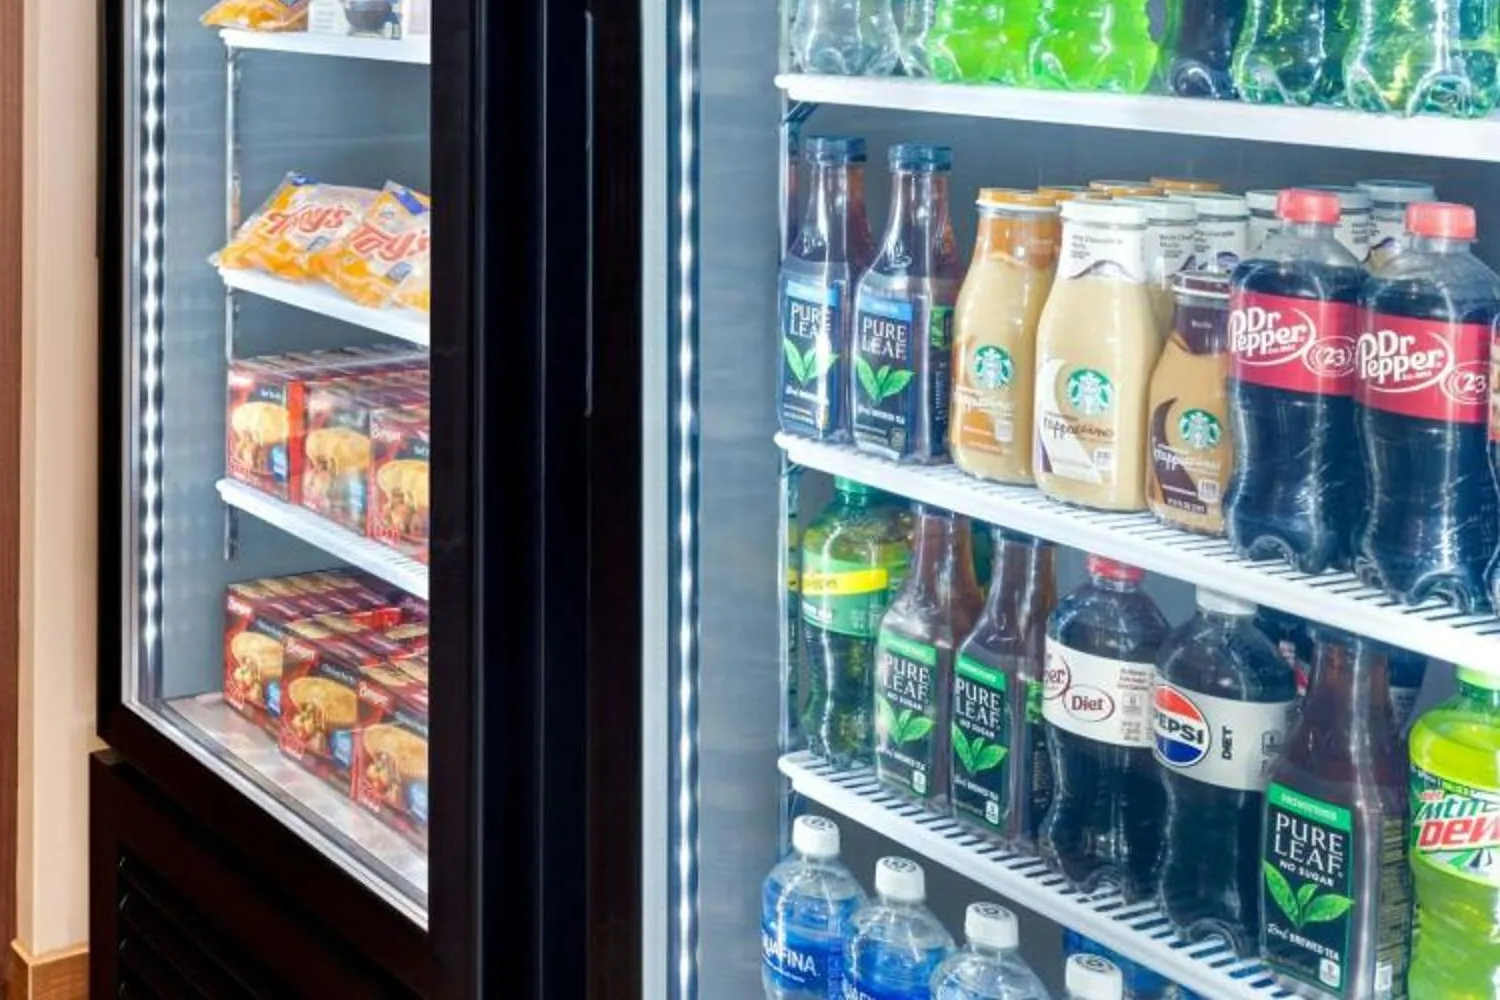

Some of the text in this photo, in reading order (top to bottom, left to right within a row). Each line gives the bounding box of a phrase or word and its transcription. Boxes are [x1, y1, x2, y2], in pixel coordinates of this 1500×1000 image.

[863, 316, 908, 344] PURE
[1247, 306, 1282, 330] Dr
[1228, 310, 1308, 357] Pepper
[1377, 330, 1416, 354] Dr
[861, 336, 907, 360] LEAF
[1322, 348, 1345, 366] 23
[1356, 333, 1445, 384] Pepper
[1462, 372, 1487, 393] 23
[883, 652, 930, 685] PURE
[883, 672, 928, 701] LEAF
[955, 677, 1001, 711] PURE
[955, 695, 1000, 730] LEAF
[1070, 695, 1104, 712] Diet
[1276, 812, 1343, 856] PURE
[1274, 833, 1344, 875] LEAF
[1279, 859, 1335, 887] NO SUGAR
